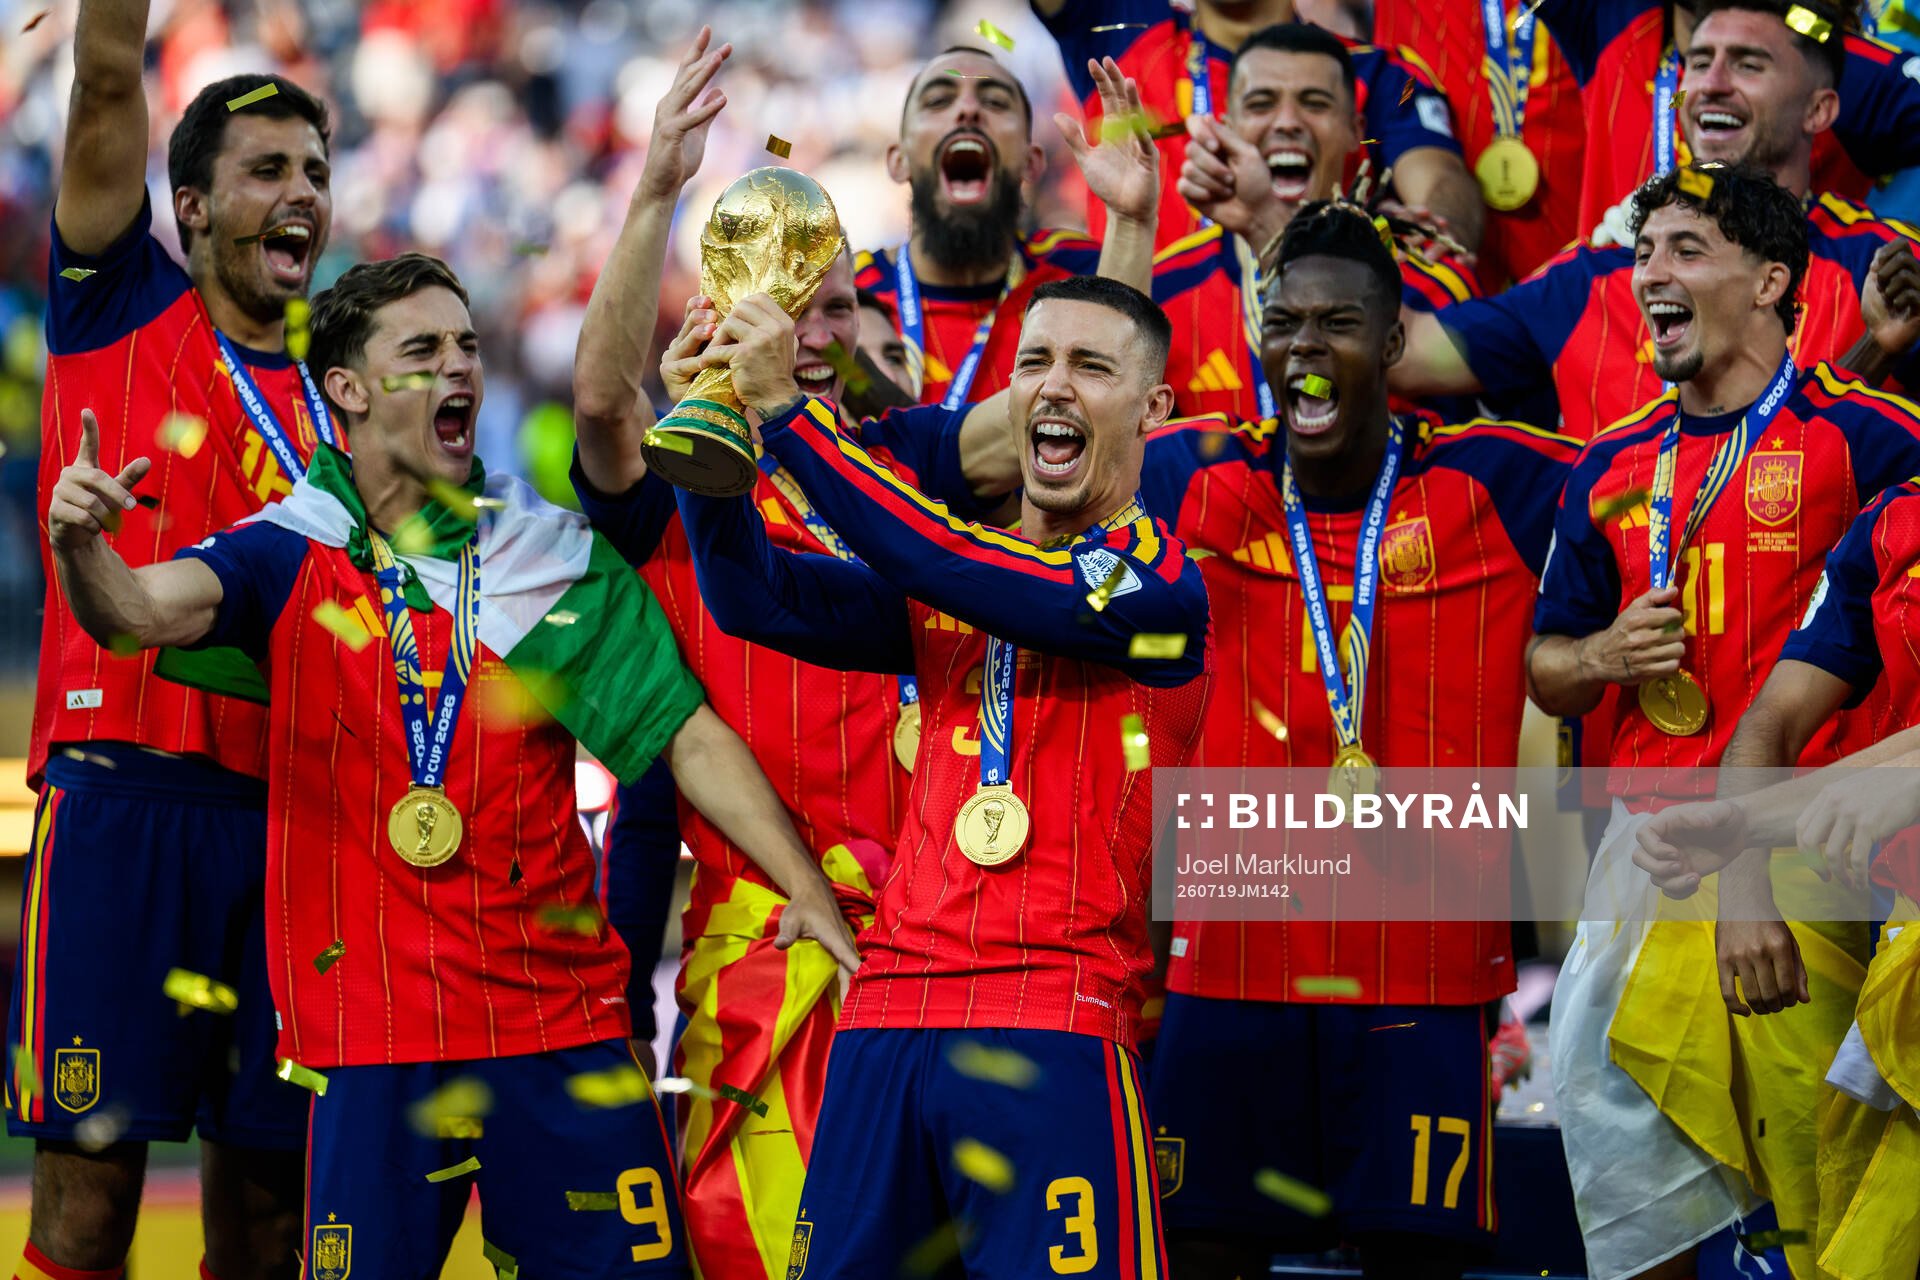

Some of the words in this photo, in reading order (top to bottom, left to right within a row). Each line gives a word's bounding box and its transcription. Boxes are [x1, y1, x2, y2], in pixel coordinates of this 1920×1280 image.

[232, 371, 263, 416] WORLD
[257, 412, 279, 442] CUP
[1758, 379, 1788, 417] 2026
[1376, 454, 1397, 500] 2026
[1369, 499, 1384, 526] CUP
[1293, 522, 1308, 554] FIFA
[1361, 526, 1378, 575] WORLD
[1301, 551, 1319, 606] WORLD
[1358, 574, 1372, 605] FIFA
[1310, 602, 1325, 629] CUP
[1317, 629, 1336, 678] 2026
[426, 744, 443, 775] CUP
[436, 694, 456, 744] 2026
[1411, 1114, 1470, 1209] 17
[616, 1167, 672, 1262] 9
[1046, 1176, 1098, 1275] 3
